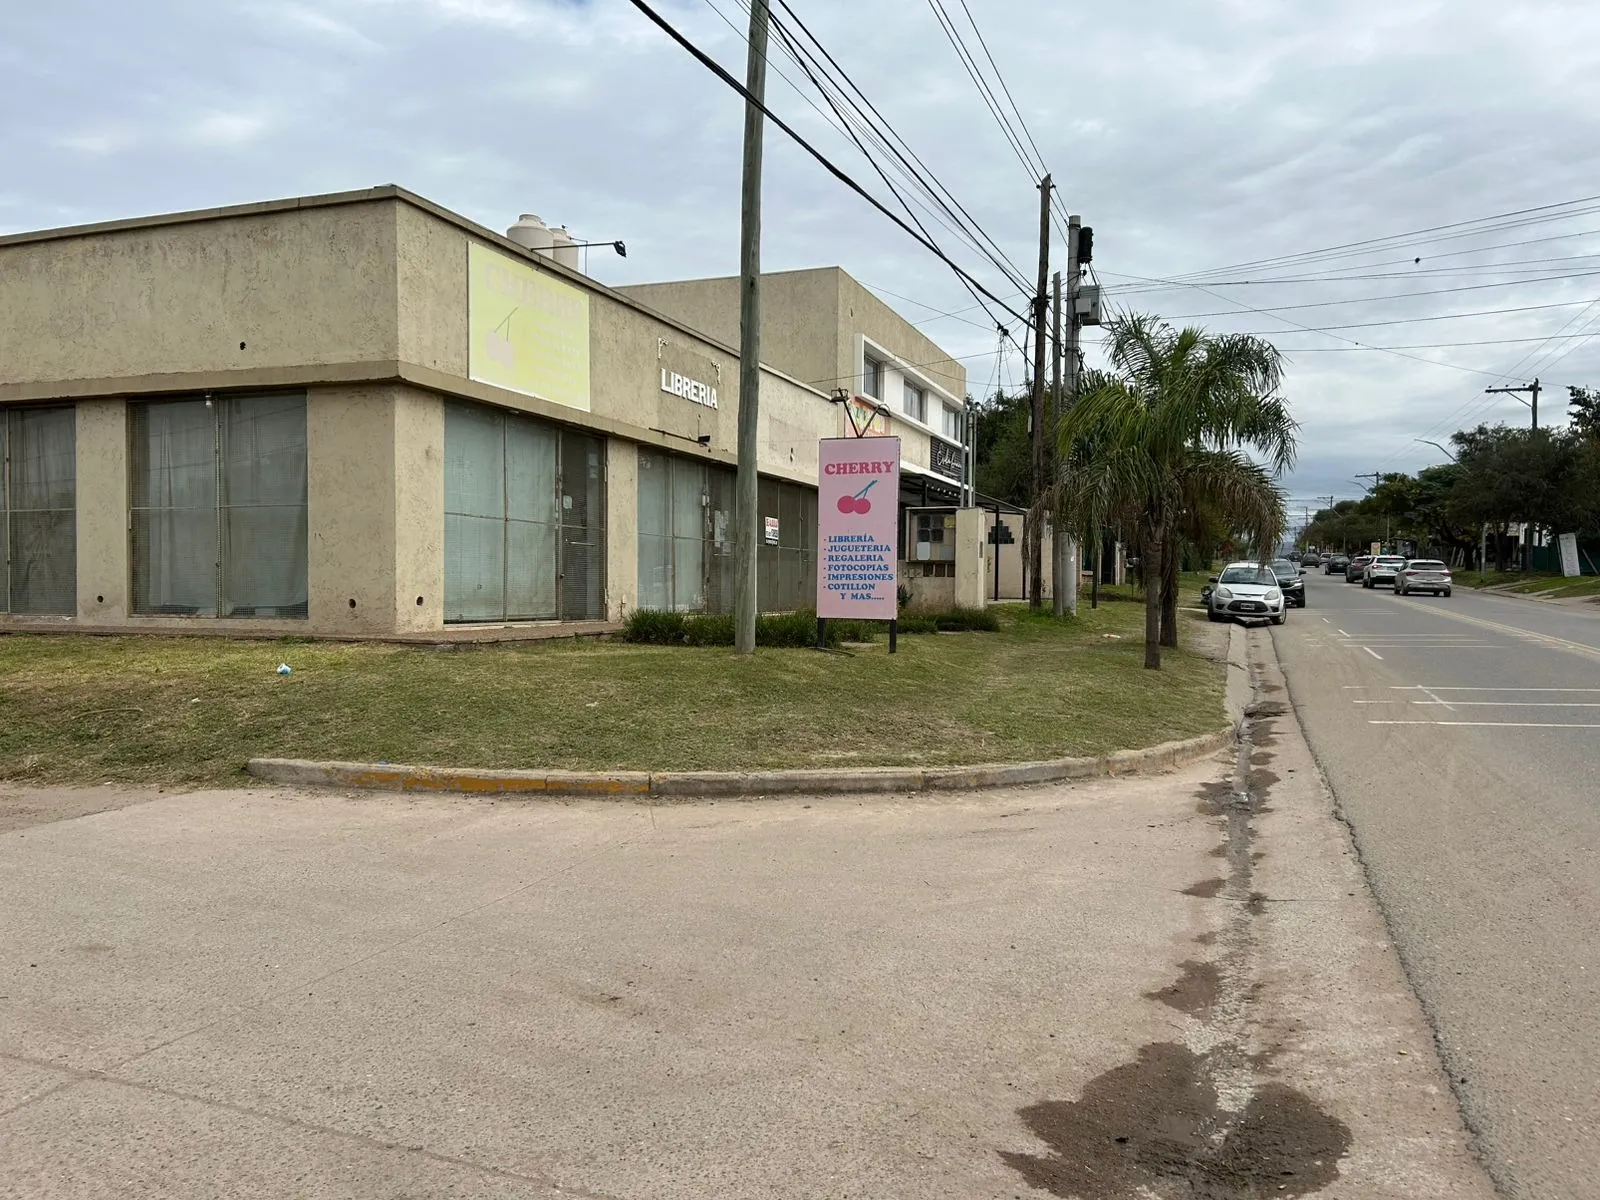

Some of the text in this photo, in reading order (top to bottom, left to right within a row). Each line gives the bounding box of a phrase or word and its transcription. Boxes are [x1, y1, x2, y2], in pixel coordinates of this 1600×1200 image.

[661, 367, 718, 410] LIBRERIA
[824, 461, 895, 474] CHERRY
[828, 533, 874, 543] LIBRERÍA
[827, 544, 891, 552] JUGUETERIA
[827, 554, 884, 562] REGALERIA
[827, 564, 889, 572] FOTOCOPIAS
[827, 573, 894, 581] IMPRESIONES
[827, 583, 876, 591] COTILLON
[839, 592, 847, 600] Y
